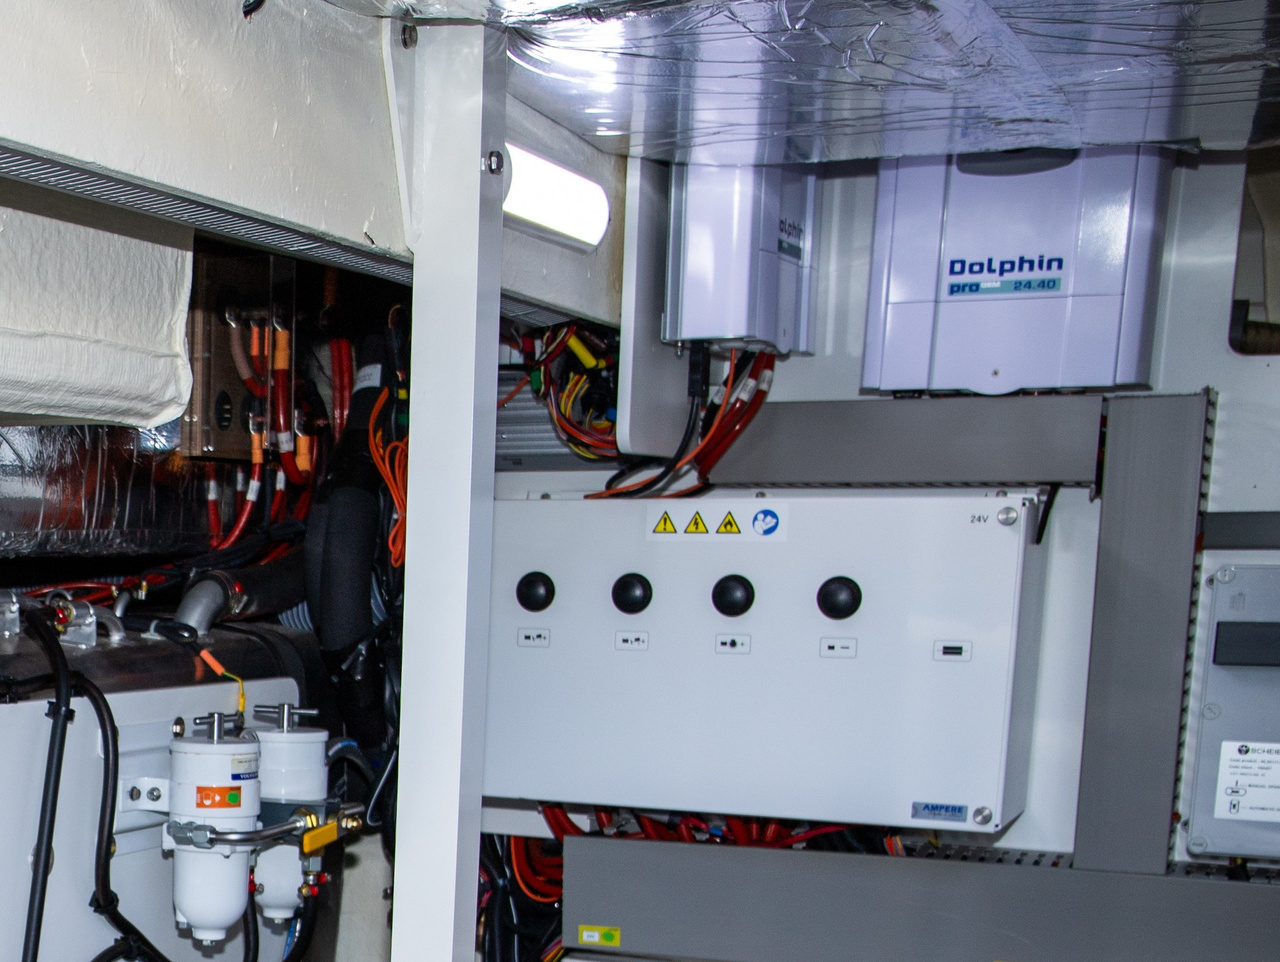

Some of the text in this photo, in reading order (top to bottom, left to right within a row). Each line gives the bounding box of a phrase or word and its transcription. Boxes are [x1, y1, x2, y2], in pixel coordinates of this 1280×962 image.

[948, 255, 1064, 277] Dolphin
[948, 282, 980, 295] pro
[1013, 280, 1056, 291] 24.40
[970, 514, 989, 524] 24V
[922, 803, 964, 814] AMPERE
